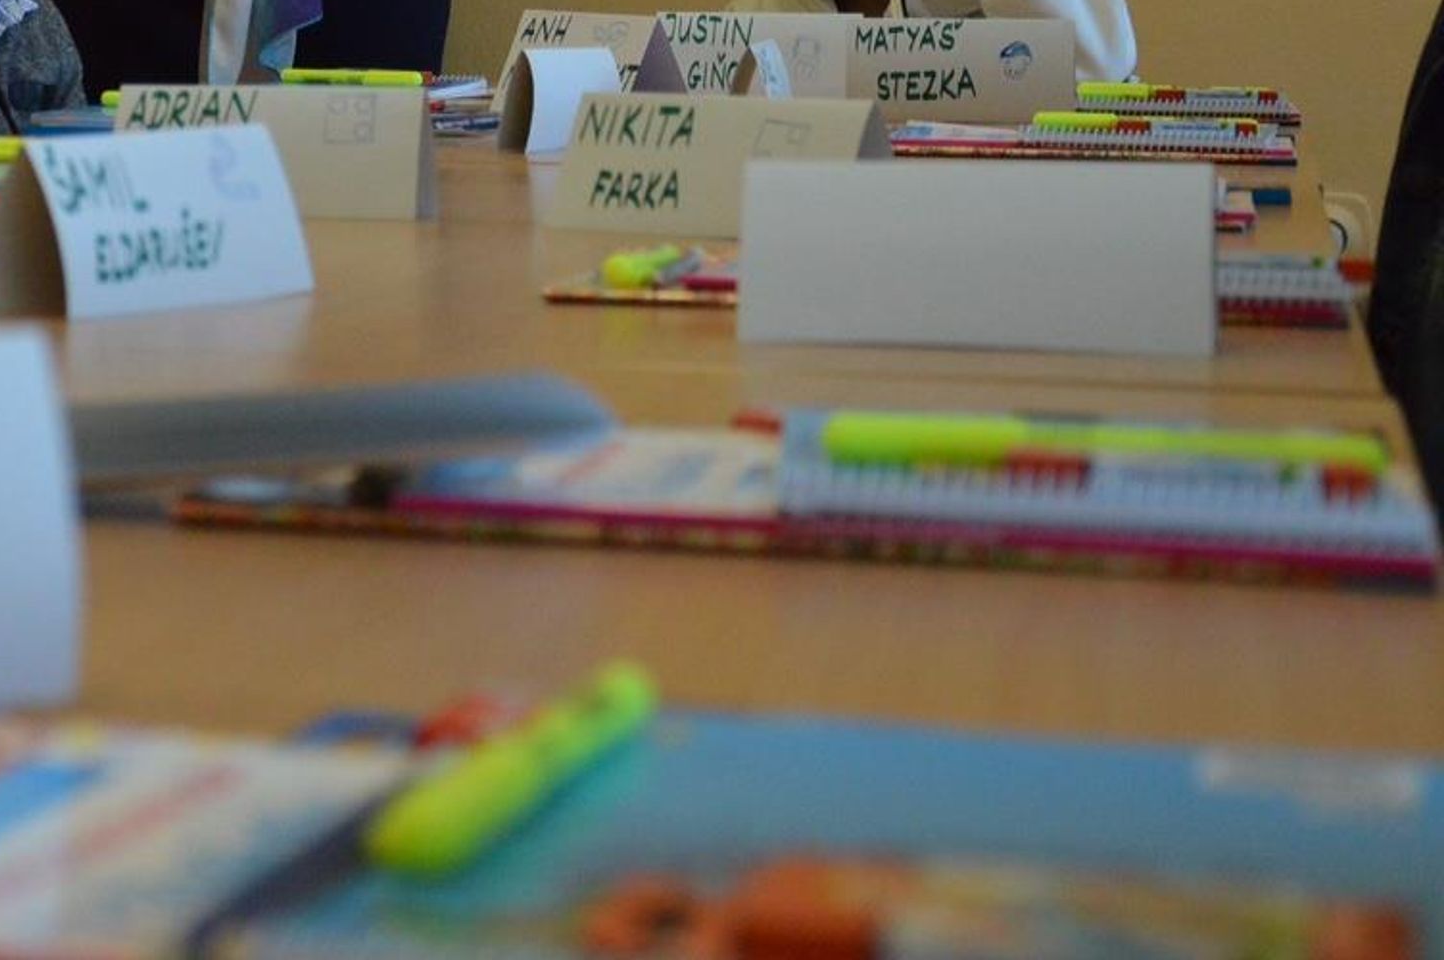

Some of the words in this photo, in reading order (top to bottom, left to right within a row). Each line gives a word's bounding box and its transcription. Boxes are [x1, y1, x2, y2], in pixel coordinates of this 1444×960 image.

[521, 15, 572, 42] ANH
[665, 13, 755, 47] JUSTIN
[855, 20, 964, 54] MATYÁŠ
[877, 67, 977, 101] STEZKA
[126, 89, 258, 130] ADRIAN
[581, 103, 697, 146] NIKITA
[589, 169, 681, 209] FARKA
